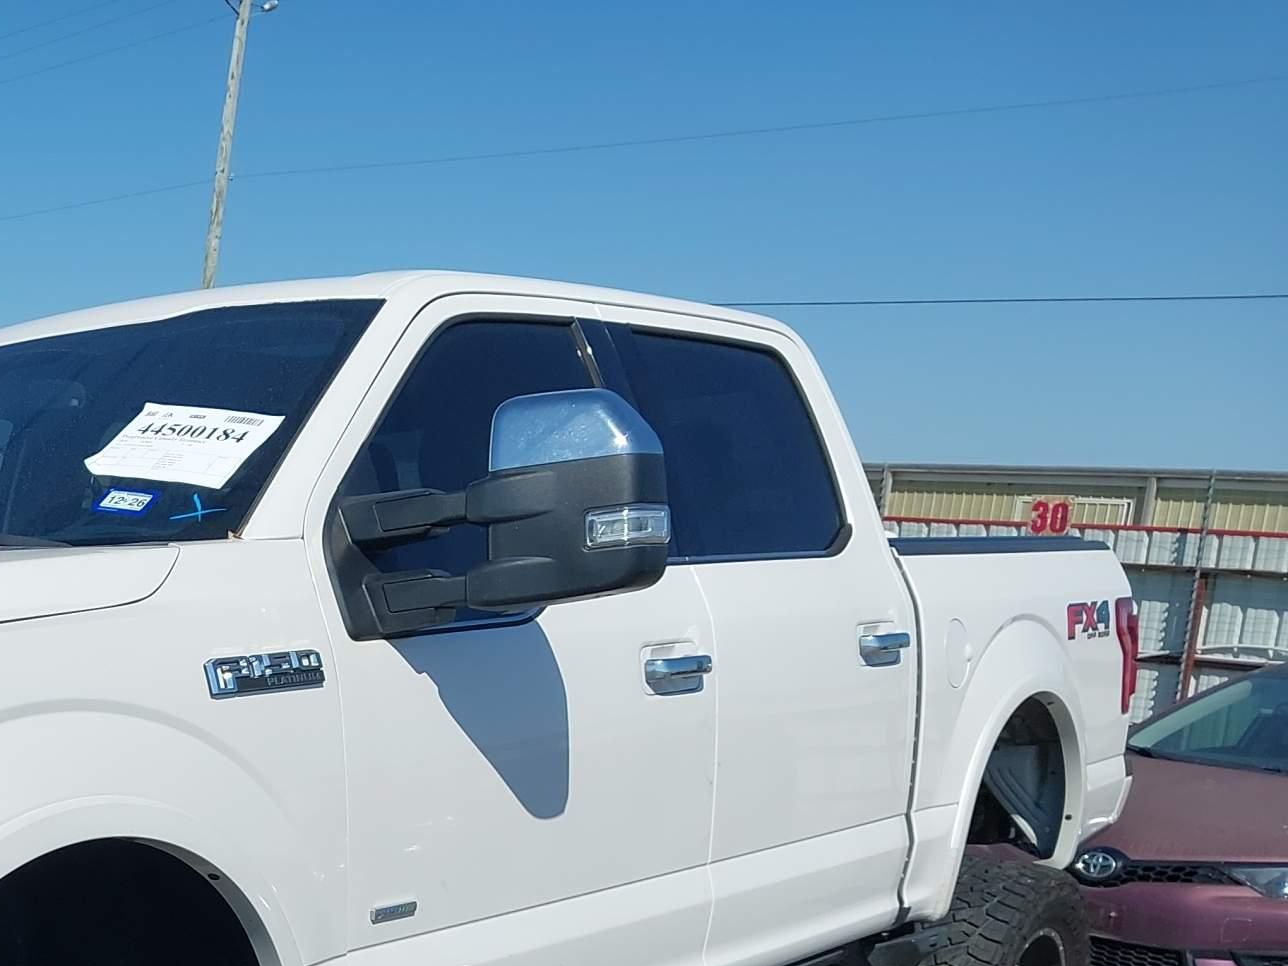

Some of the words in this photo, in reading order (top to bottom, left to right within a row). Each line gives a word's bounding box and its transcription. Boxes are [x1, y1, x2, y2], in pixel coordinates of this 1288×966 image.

[138, 422, 250, 443] 44500184
[1031, 500, 1069, 533] 30
[1067, 600, 1110, 640] FX4
[267, 672, 322, 686] PLATINUM
